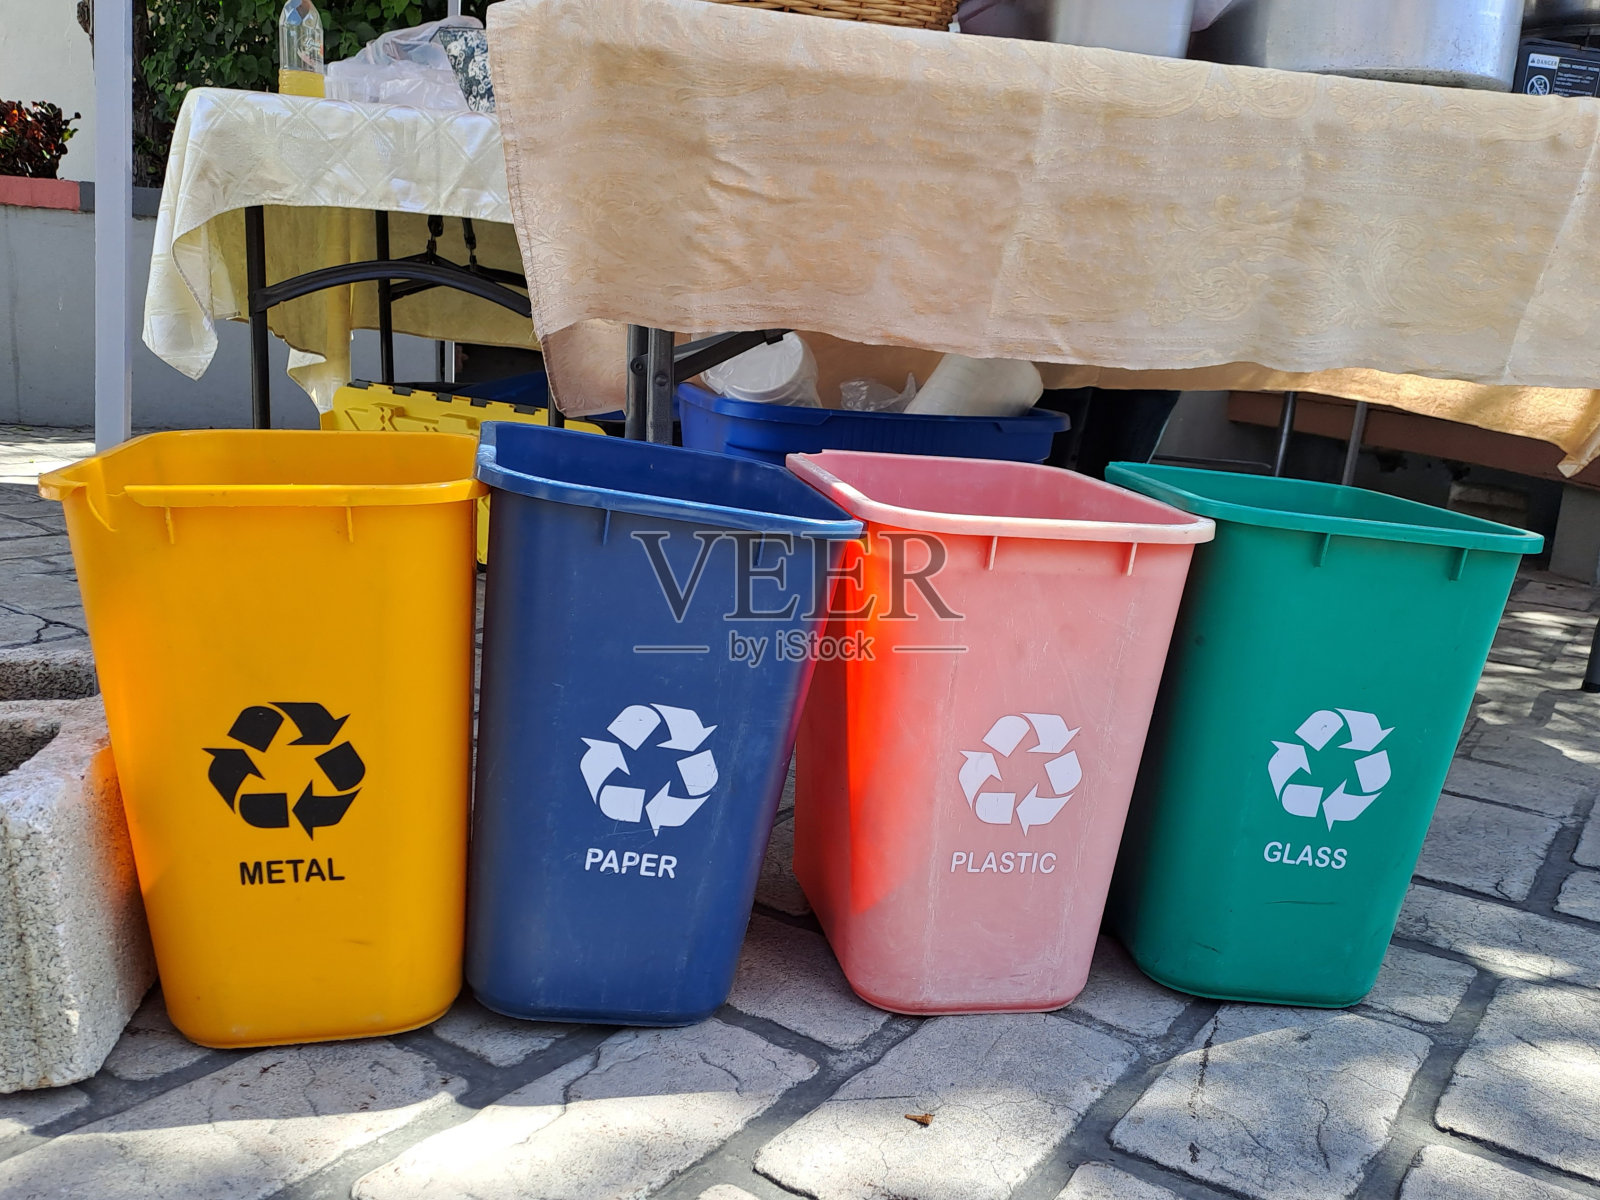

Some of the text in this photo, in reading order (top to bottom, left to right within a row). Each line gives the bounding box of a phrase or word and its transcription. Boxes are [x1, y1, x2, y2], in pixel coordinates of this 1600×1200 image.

[1536, 59, 1557, 67] DANGER
[584, 847, 678, 879] PAPER
[950, 851, 1057, 874] PLASTIC
[1263, 841, 1348, 870] GLASS
[239, 857, 346, 886] METAL
